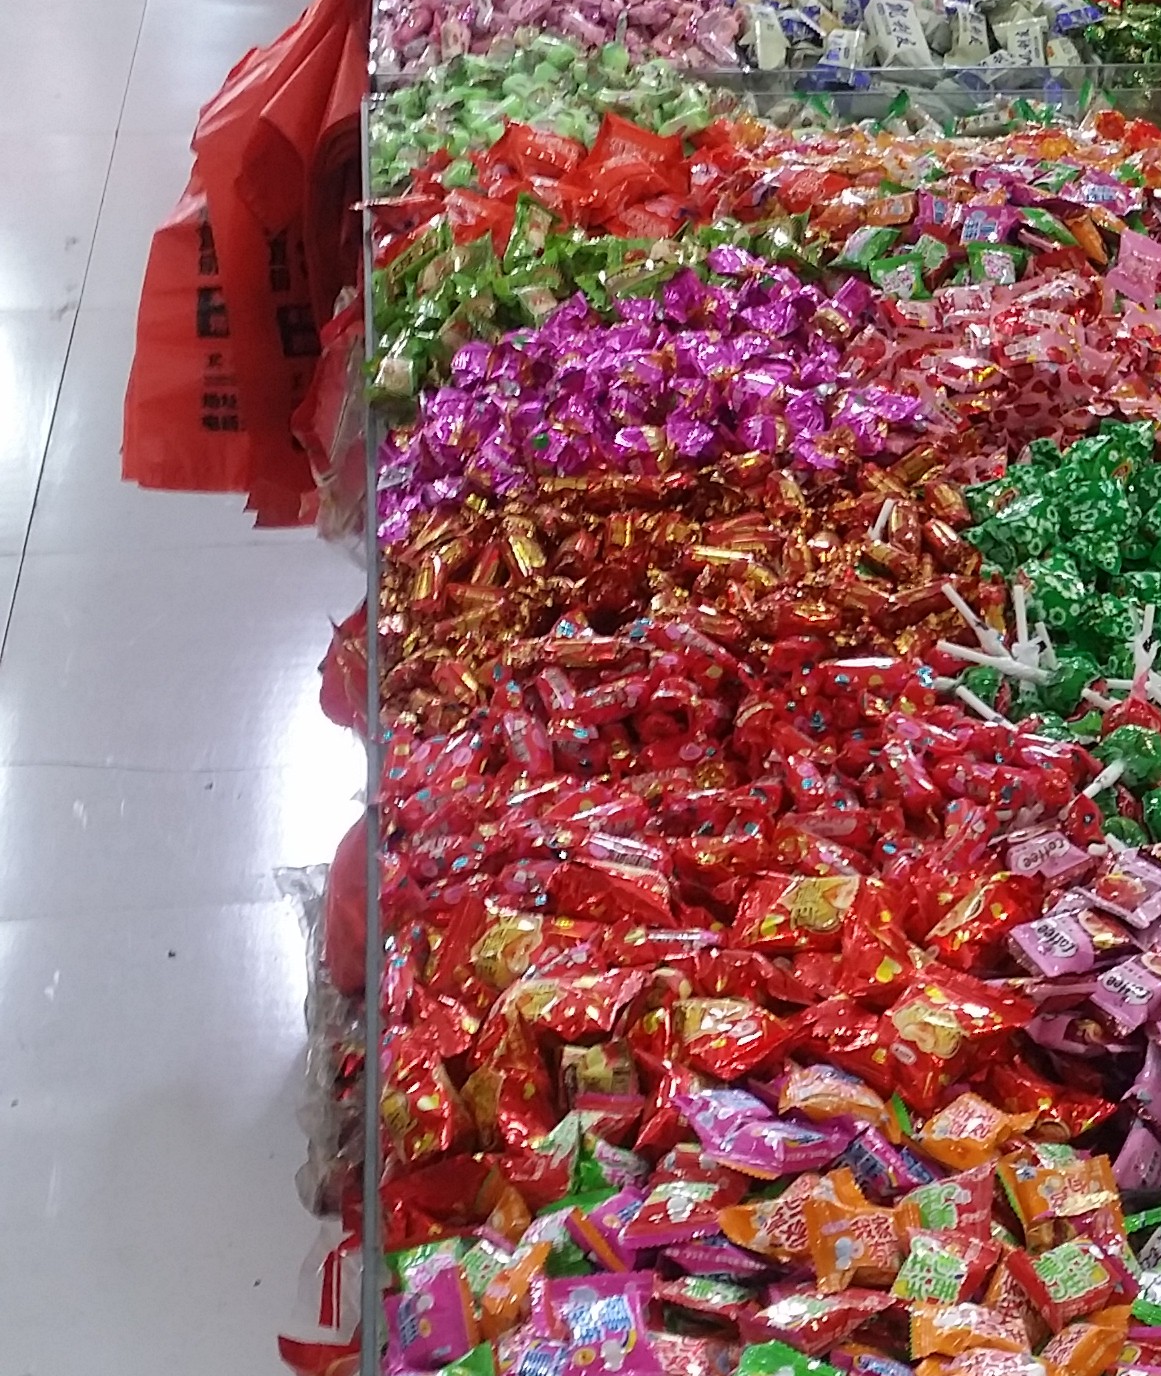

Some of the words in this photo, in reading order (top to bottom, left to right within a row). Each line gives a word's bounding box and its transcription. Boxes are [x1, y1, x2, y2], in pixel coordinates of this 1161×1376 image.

[1021, 836, 1067, 869] Coffee
[1035, 923, 1077, 957] Coffee
[1103, 973, 1152, 1006] Coffee
